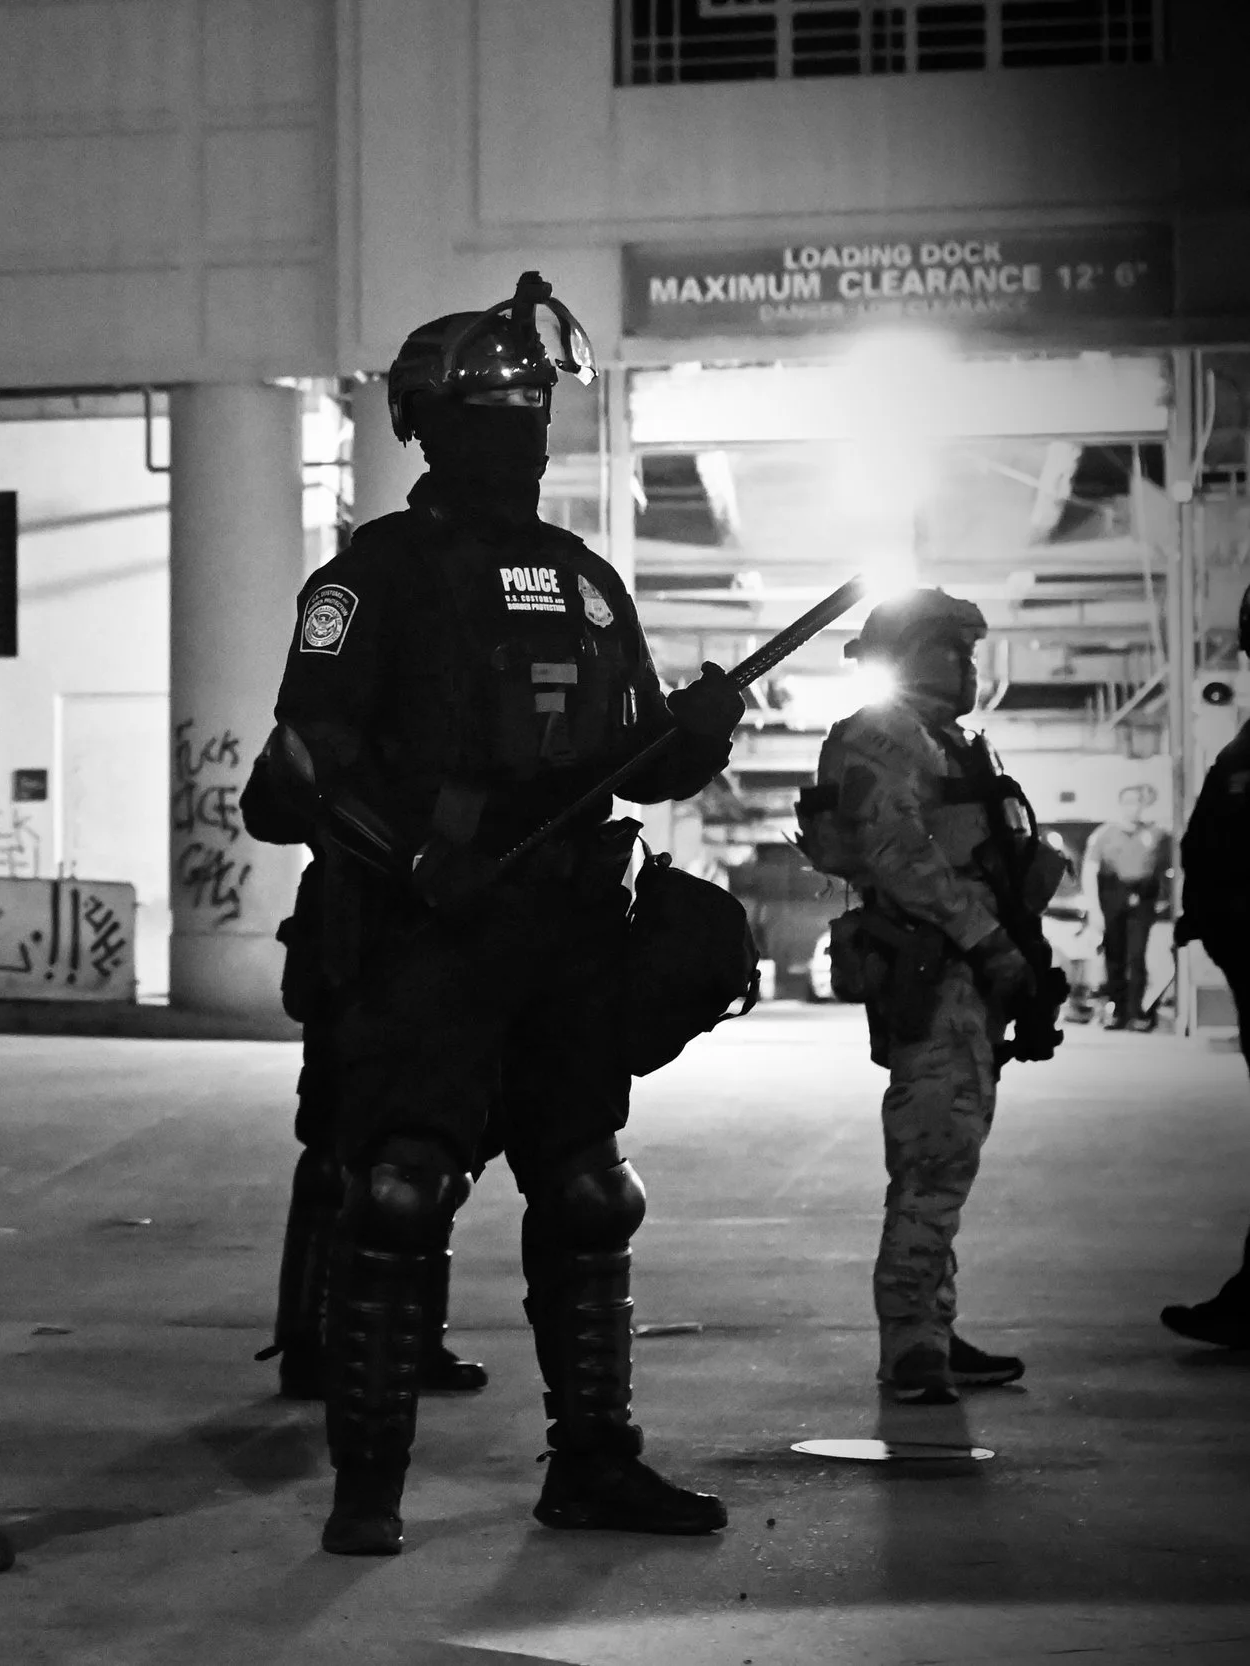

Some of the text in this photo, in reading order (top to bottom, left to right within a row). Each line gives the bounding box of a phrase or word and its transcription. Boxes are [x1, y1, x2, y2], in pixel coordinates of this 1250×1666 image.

[783, 240, 1001, 270] LOADING DOCK
[650, 272, 821, 304] MAXIMUM
[839, 263, 1042, 299] CLEARANCE
[499, 567, 560, 593] POLICE
[520, 595, 553, 603] CUSTOMS
